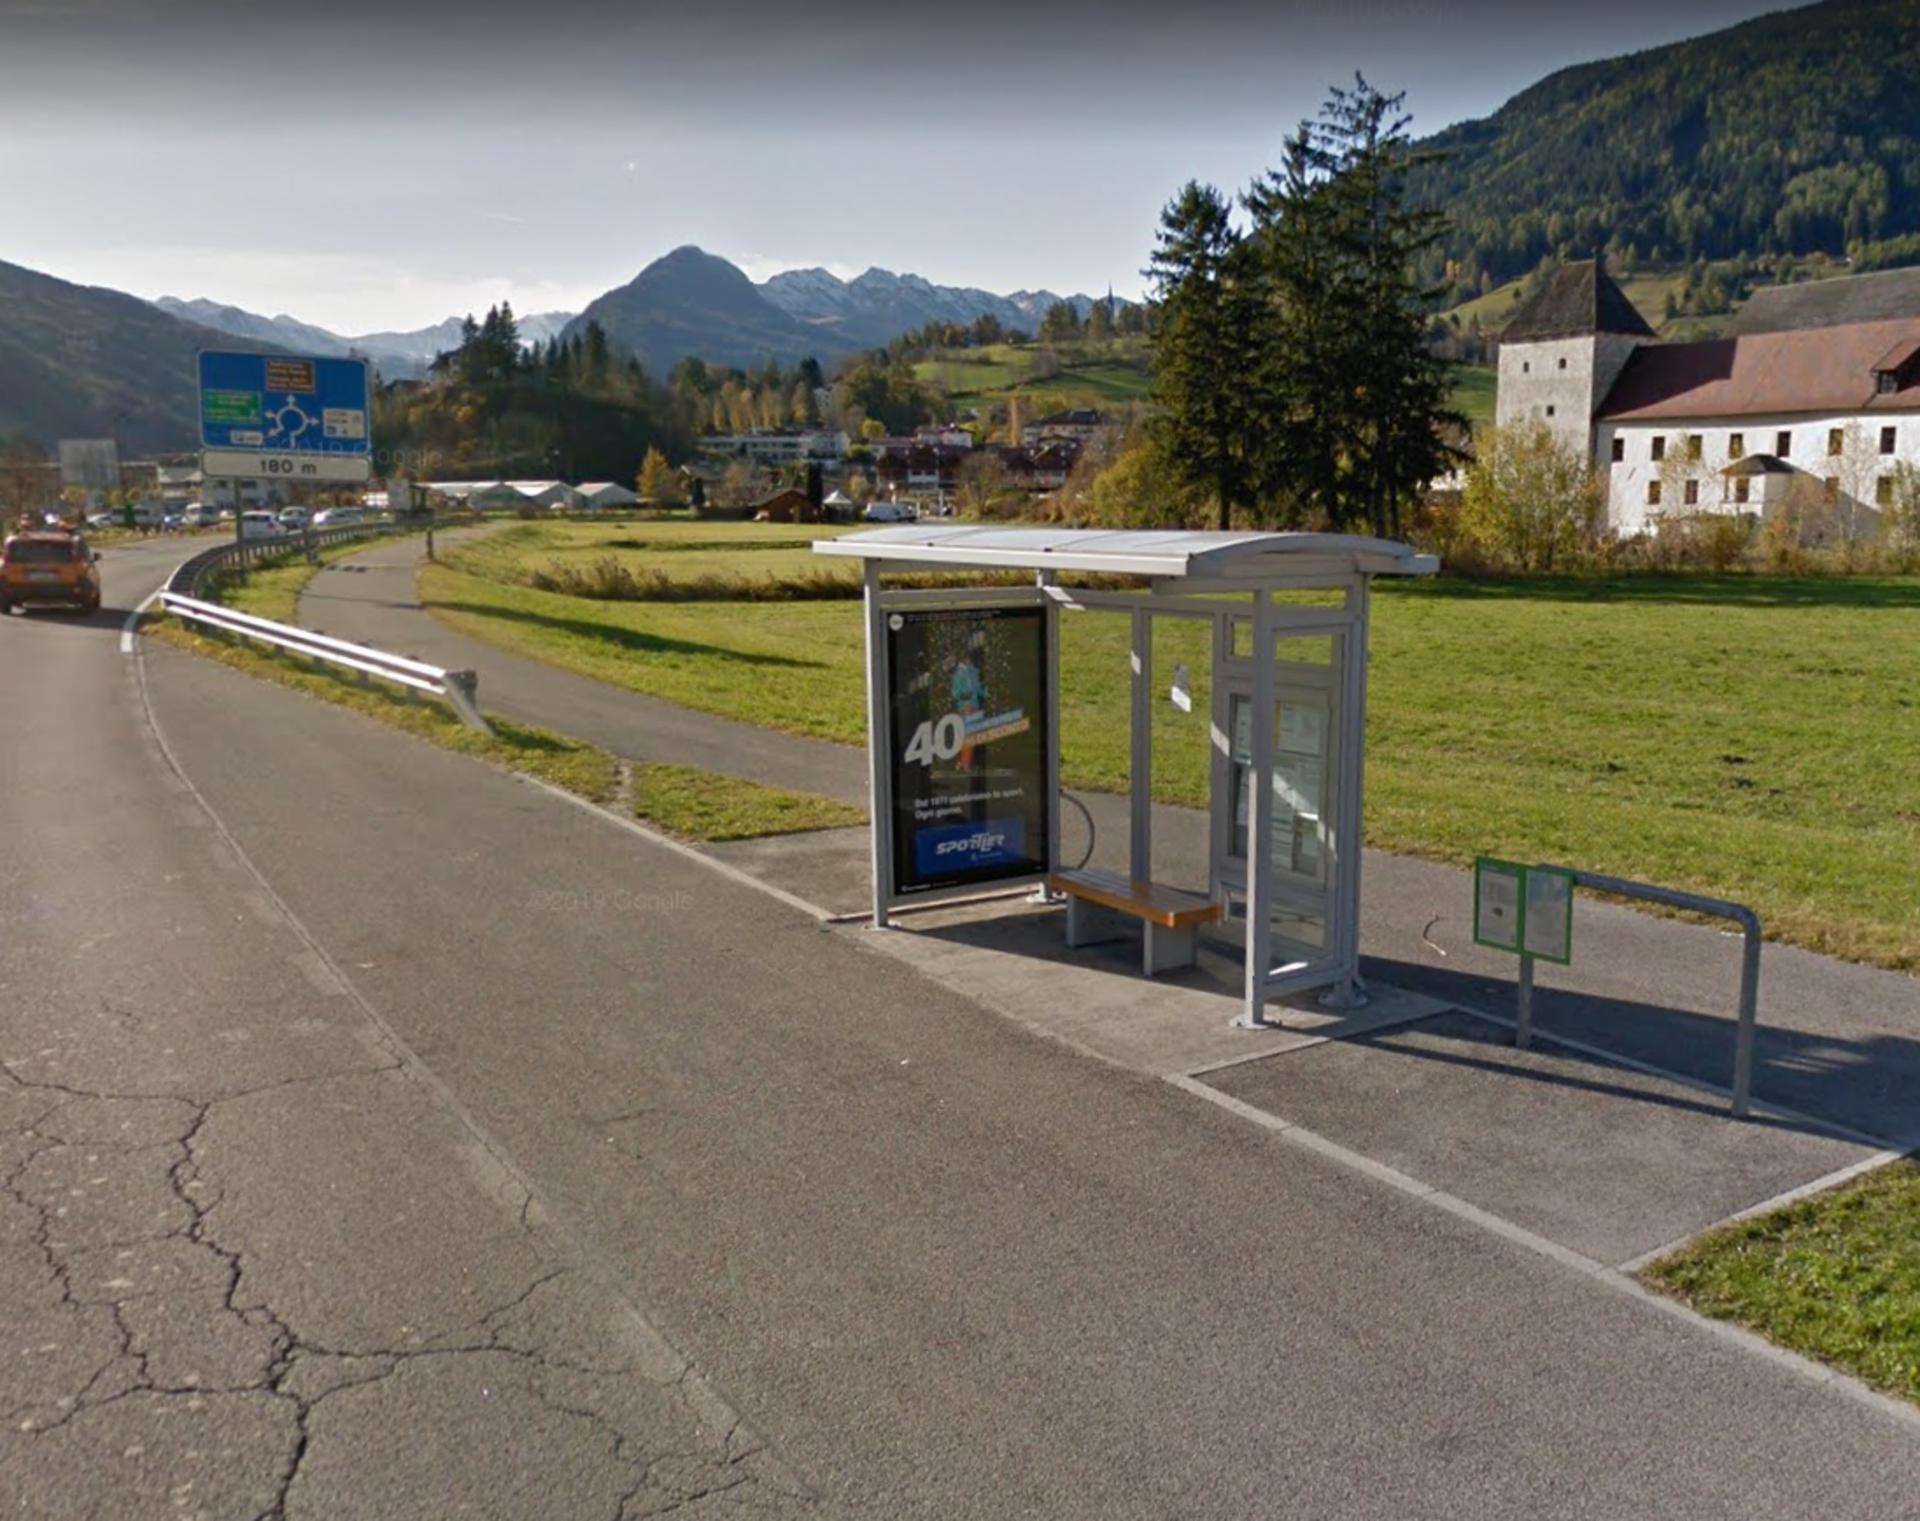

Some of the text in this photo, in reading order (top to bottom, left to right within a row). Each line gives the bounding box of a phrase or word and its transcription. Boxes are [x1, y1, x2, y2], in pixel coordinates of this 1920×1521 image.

[260, 458, 317, 475] 180 m
[904, 712, 966, 767] 40
